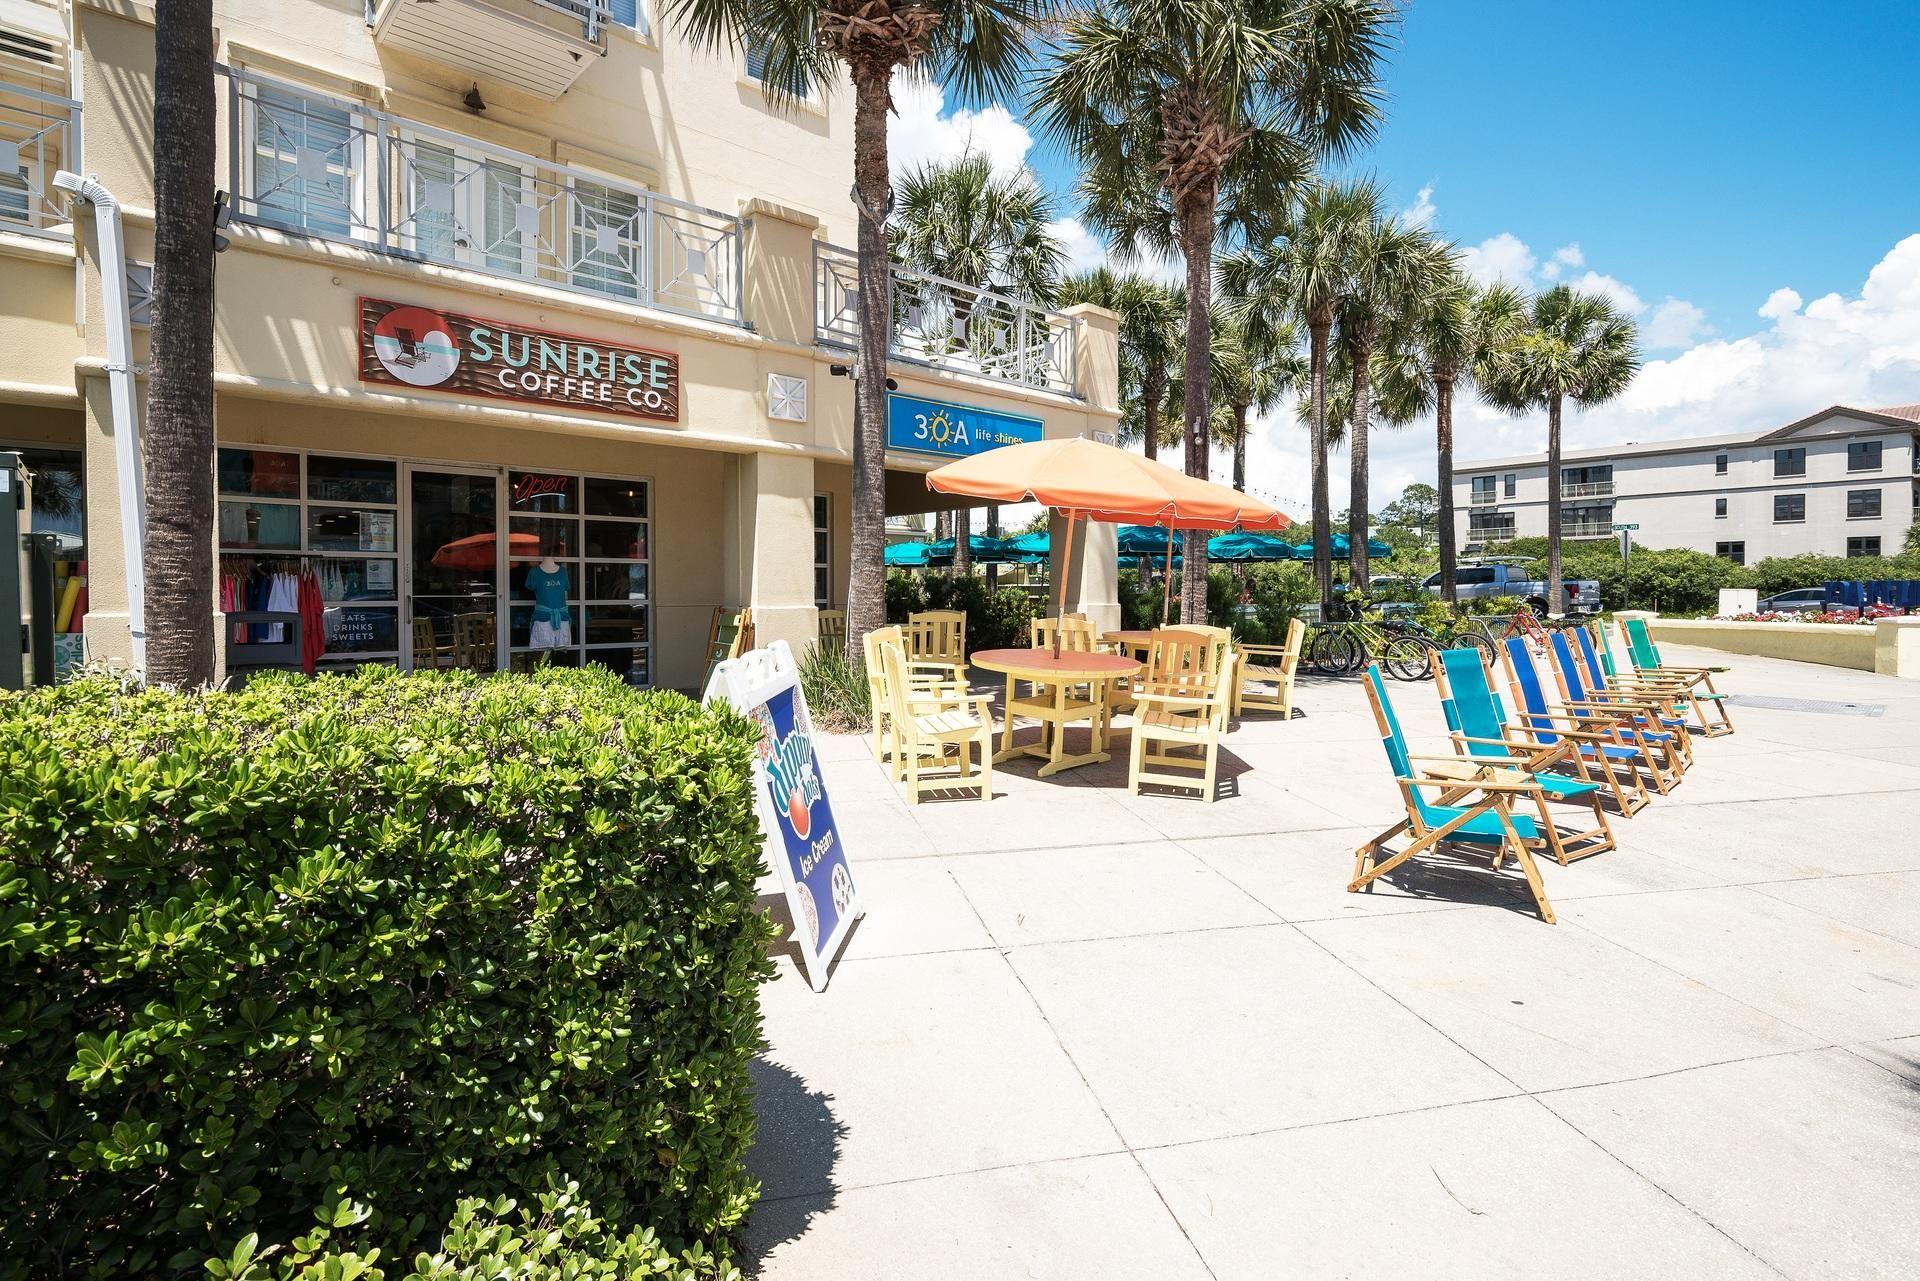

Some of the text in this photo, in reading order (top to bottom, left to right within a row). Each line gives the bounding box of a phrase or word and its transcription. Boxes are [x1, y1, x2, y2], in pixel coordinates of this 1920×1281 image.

[469, 328, 669, 390] SUNRISE
[498, 368, 669, 411] COFFEE CO.
[975, 429, 992, 441] life
[994, 433, 1024, 445] shines
[515, 474, 567, 505] Open
[332, 632, 374, 641] SWEETS
[333, 623, 373, 632] DRINKS
[800, 829, 834, 879] Ice Cream
